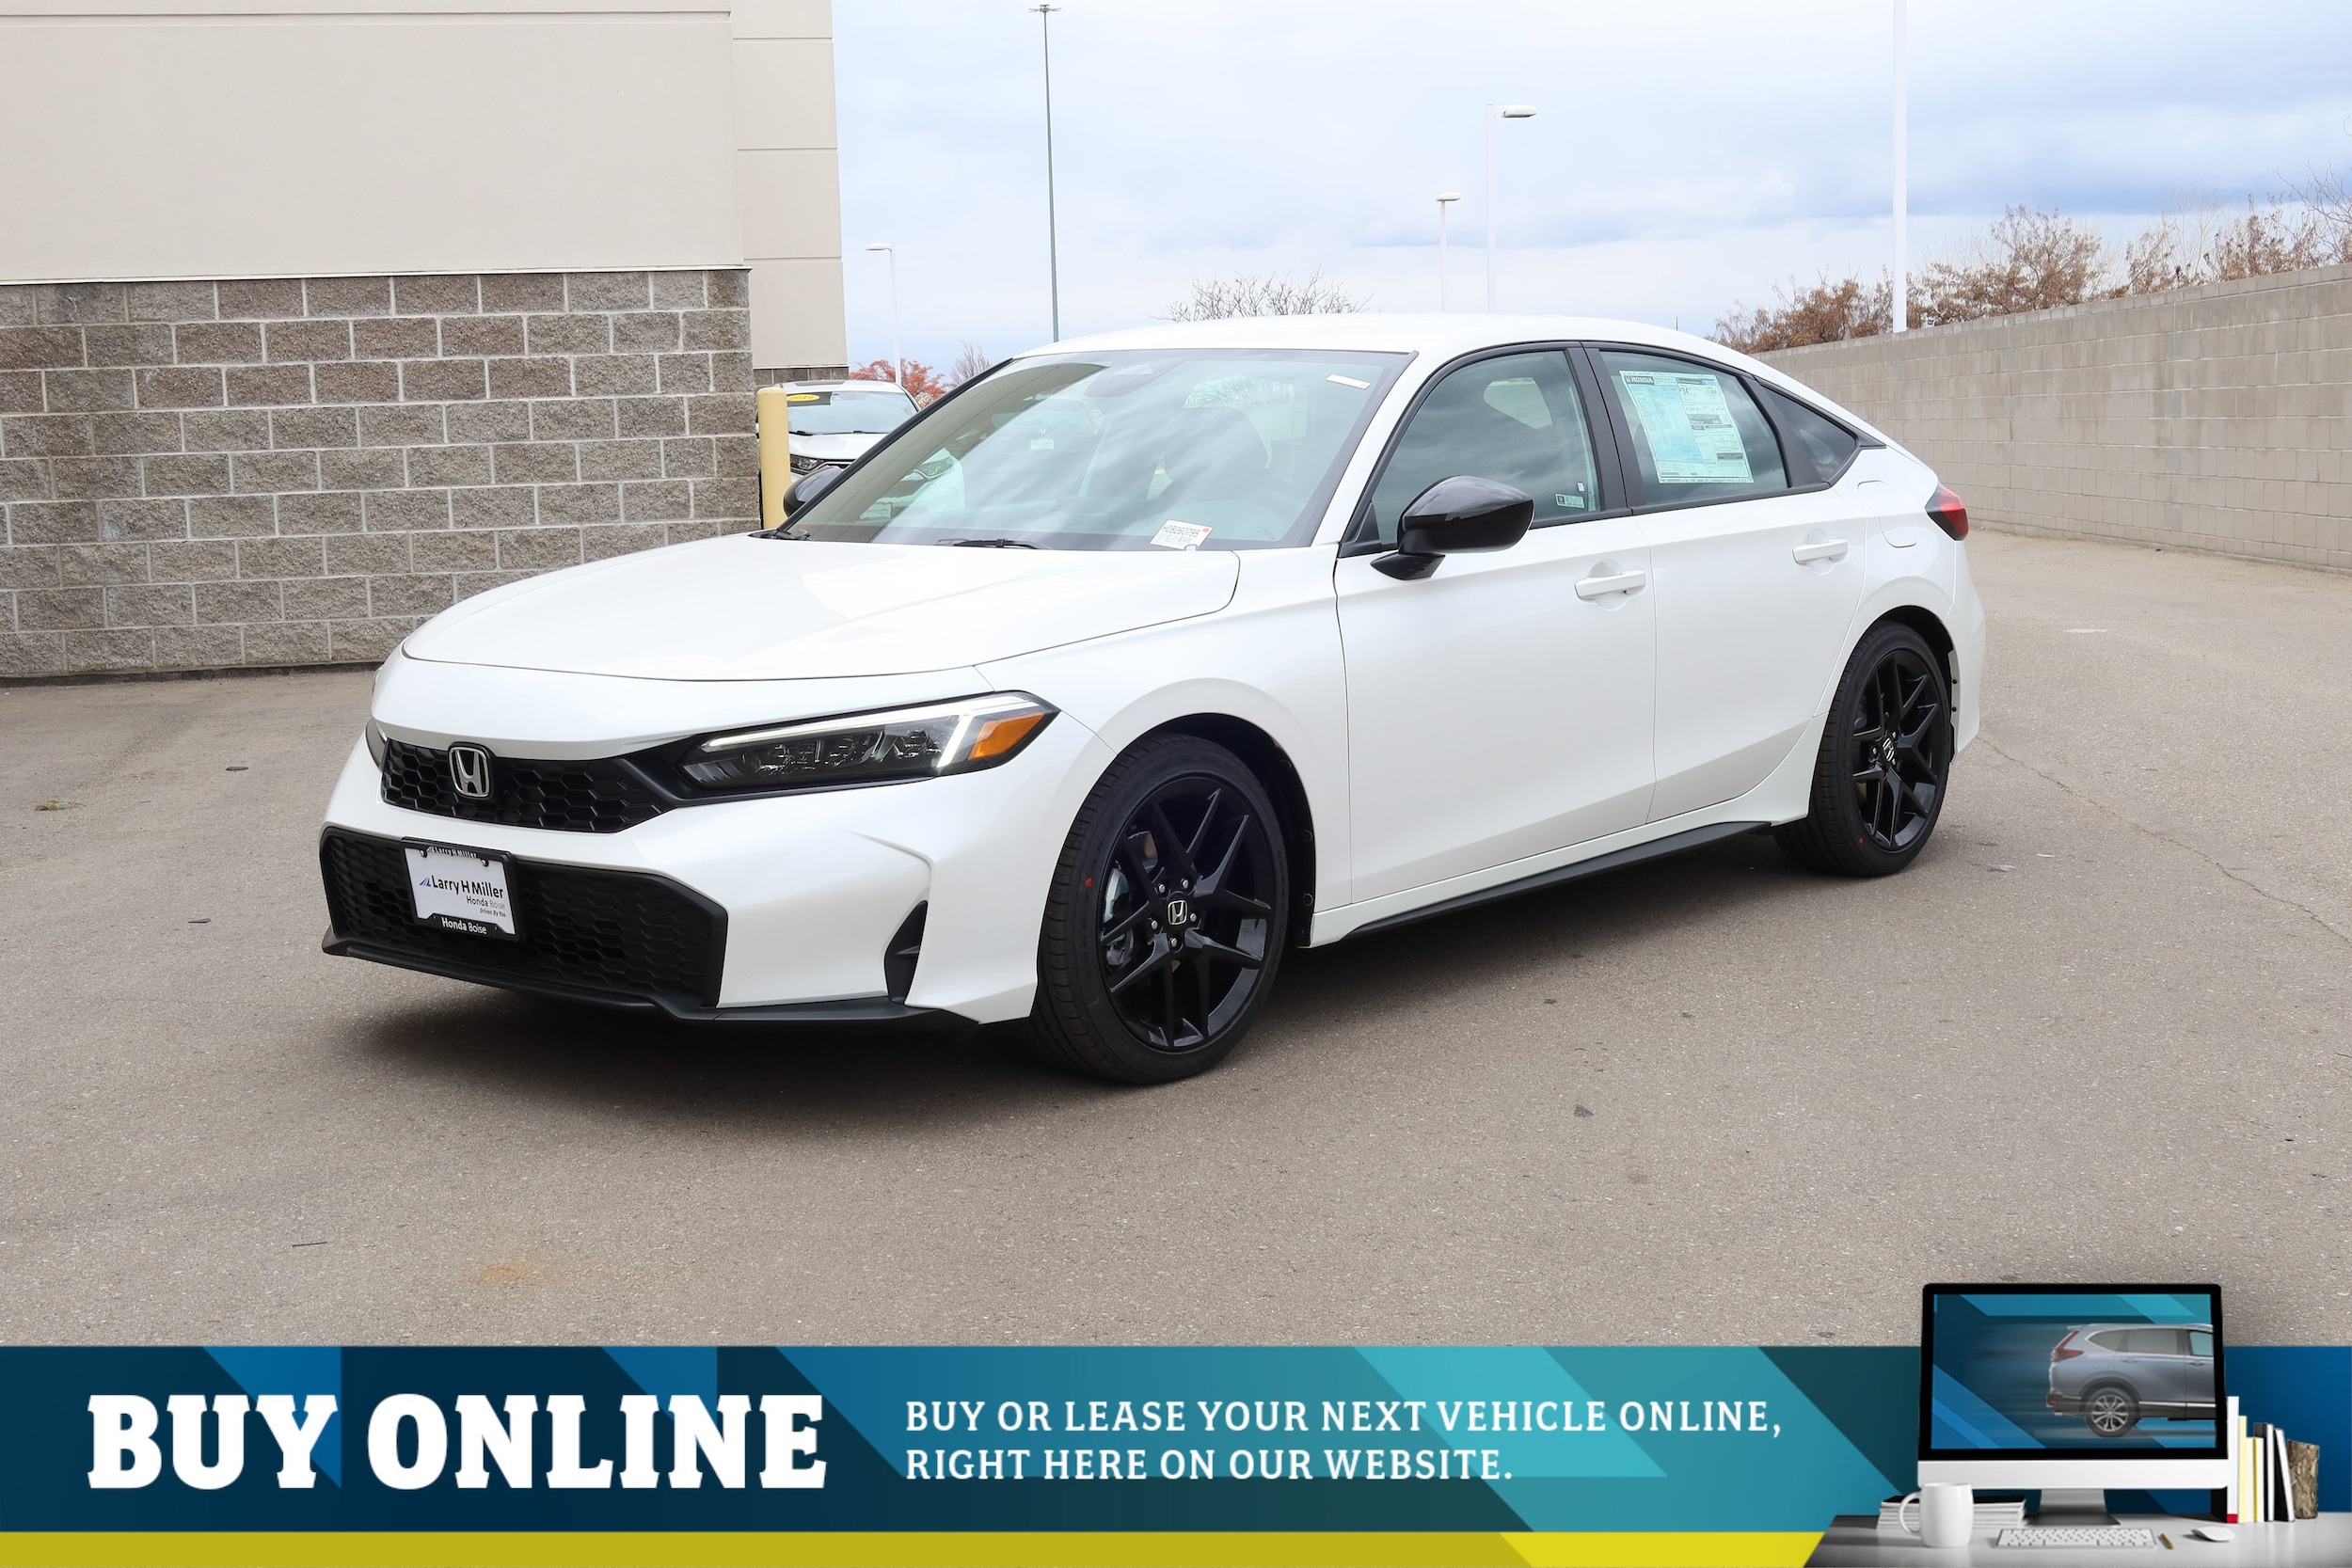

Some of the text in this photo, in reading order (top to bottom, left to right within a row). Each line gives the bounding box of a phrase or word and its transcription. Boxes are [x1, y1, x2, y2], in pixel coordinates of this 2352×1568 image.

[431, 875, 504, 898] Larry H Miller
[466, 895, 506, 911] Honda Boise
[441, 916, 487, 935] Honda Boise
